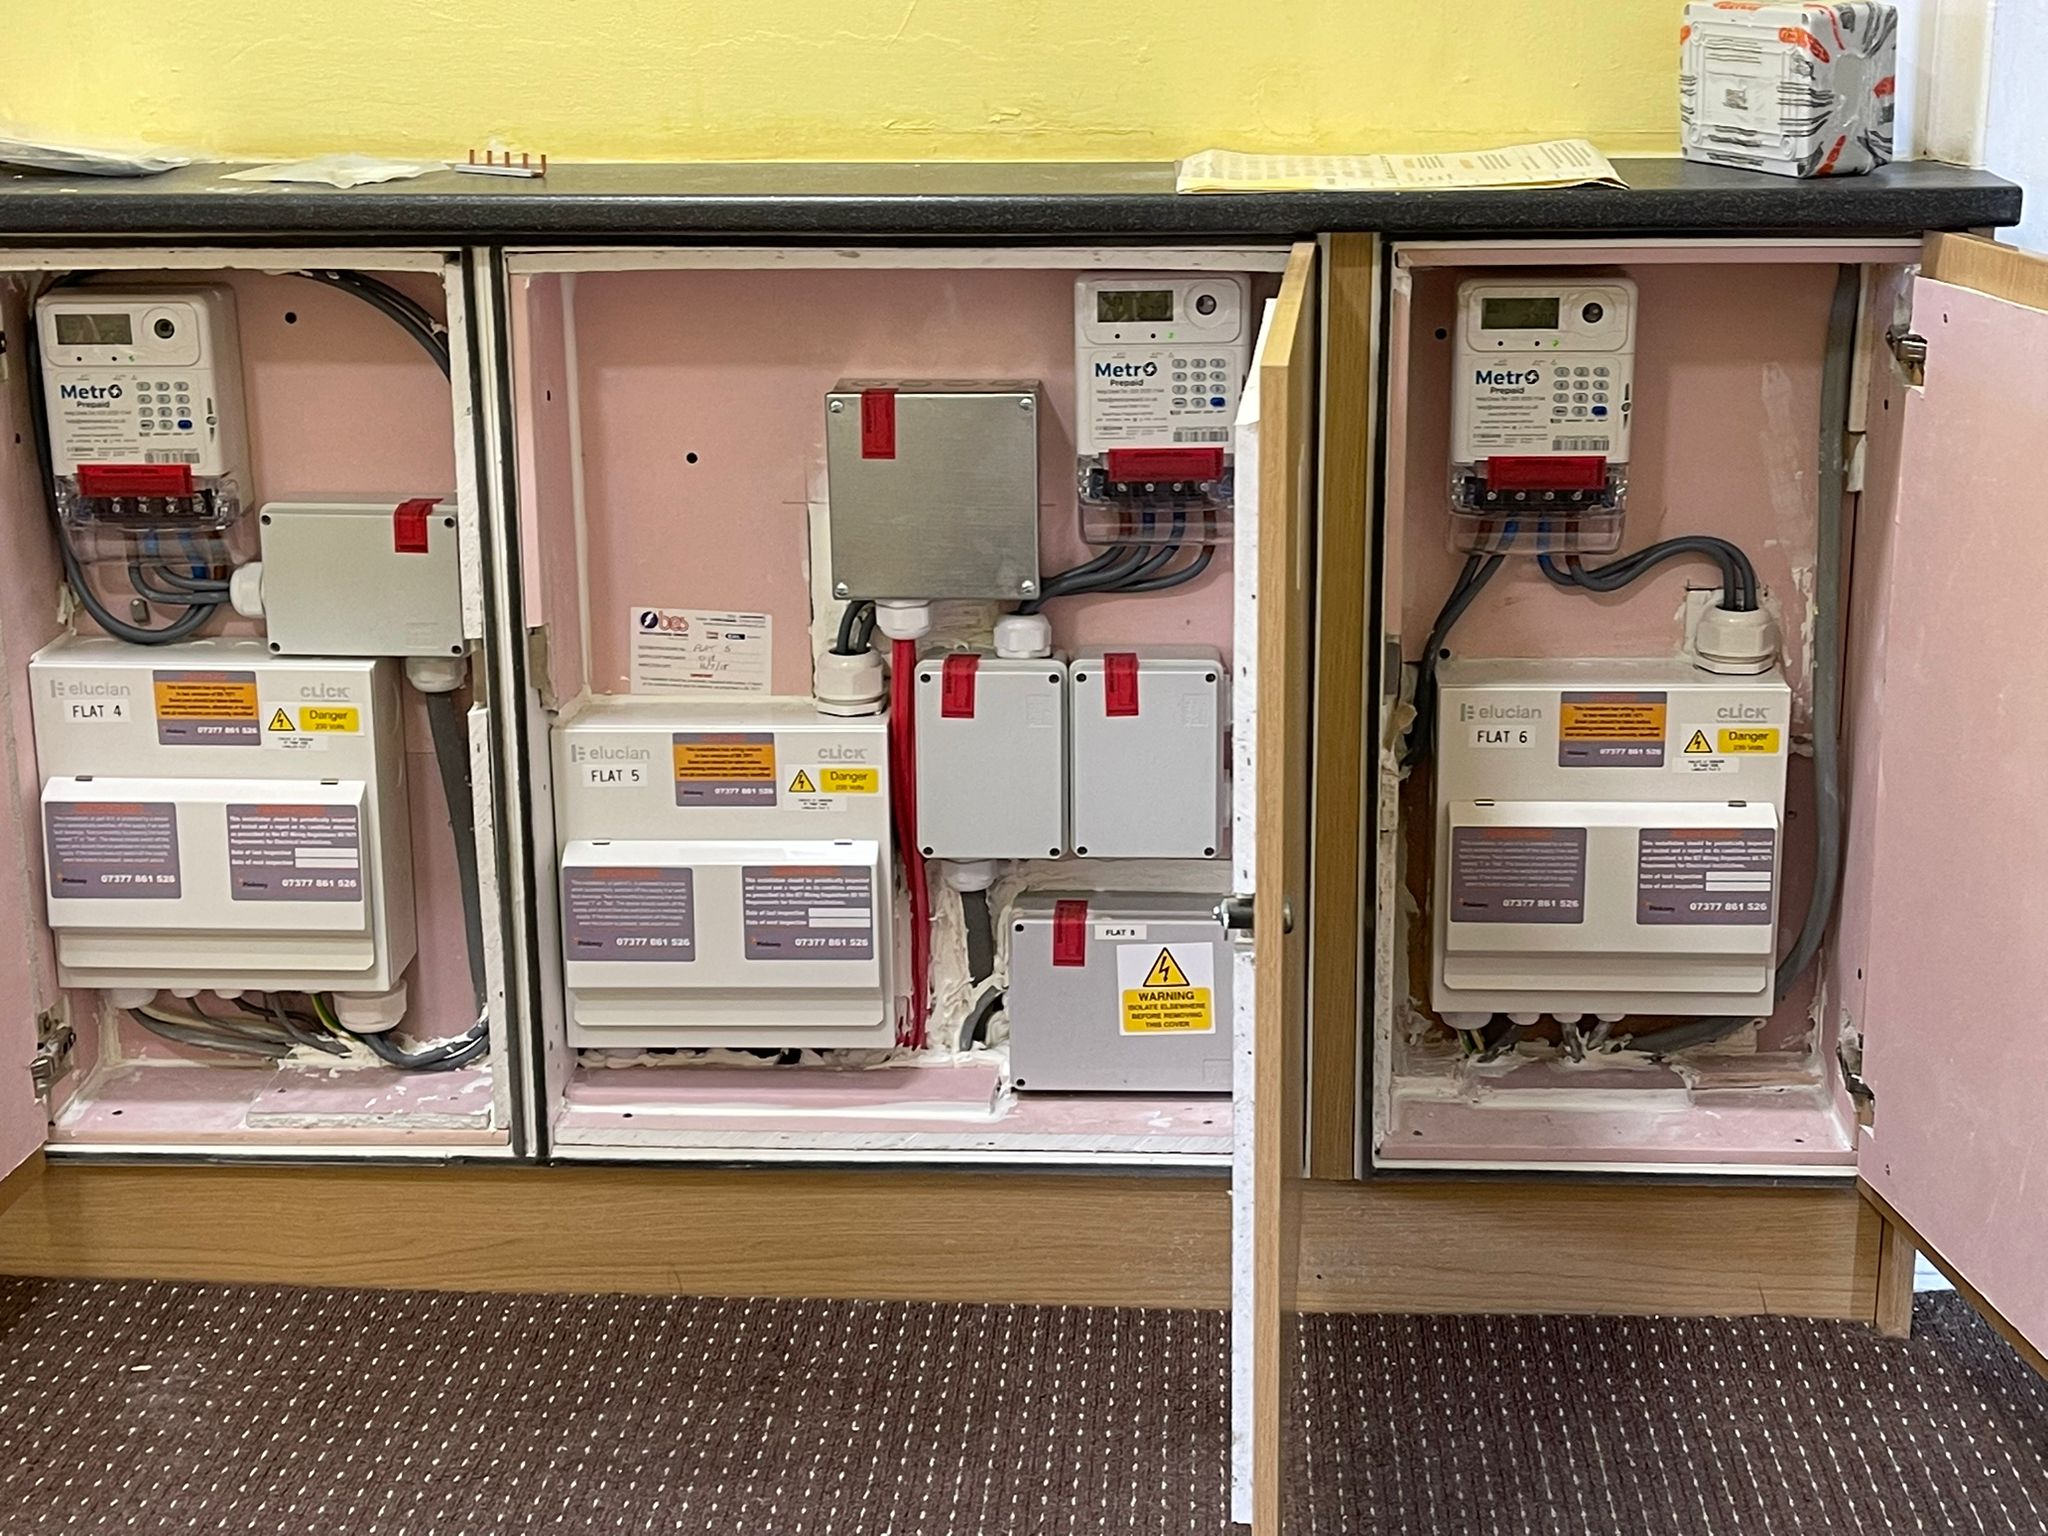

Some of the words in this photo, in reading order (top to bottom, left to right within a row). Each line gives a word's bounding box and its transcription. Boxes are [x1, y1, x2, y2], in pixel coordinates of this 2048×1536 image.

[1095, 361, 1158, 377] Metro
[1110, 379, 1144, 387] Prepaid
[1475, 369, 1540, 385] Metro
[60, 384, 123, 399] Metro
[1489, 387, 1525, 395] Prepaid
[68, 681, 131, 696] elucian
[72, 705, 104, 718] FLAT
[113, 705, 122, 717] 4
[309, 710, 348, 722] Danger
[1479, 704, 1542, 719] elucian
[1477, 730, 1511, 743] FLAT
[1518, 730, 1528, 743] 6
[1728, 731, 1769, 743] Danger
[589, 745, 651, 760] elucian
[591, 769, 623, 782] FLAT
[631, 769, 640, 782] 5
[830, 771, 868, 783] Danger
[100, 874, 132, 883] 07377
[134, 875, 154, 883] 861
[281, 879, 314, 887] 07377
[315, 879, 334, 888] 861
[337, 879, 357, 888] 526
[1502, 899, 1536, 908] 07377
[1537, 900, 1556, 908] 861
[1559, 900, 1580, 908] 526
[1689, 902, 1722, 911] 07377
[1724, 902, 1744, 911] 861
[1747, 902, 1768, 911] 526
[616, 937, 648, 946] 07377
[649, 938, 668, 946] 861
[670, 938, 690, 946] 526
[794, 938, 826, 947] 07377
[828, 938, 847, 947] 861
[849, 938, 869, 947] 526
[1138, 991, 1195, 1001] WARNING
[1127, 1003, 1158, 1011] ISOLATE
[1160, 1002, 1206, 1010] ELSEWHERE
[1131, 1012, 1161, 1020] BEFORE
[1163, 1011, 1203, 1019] REMOVING
